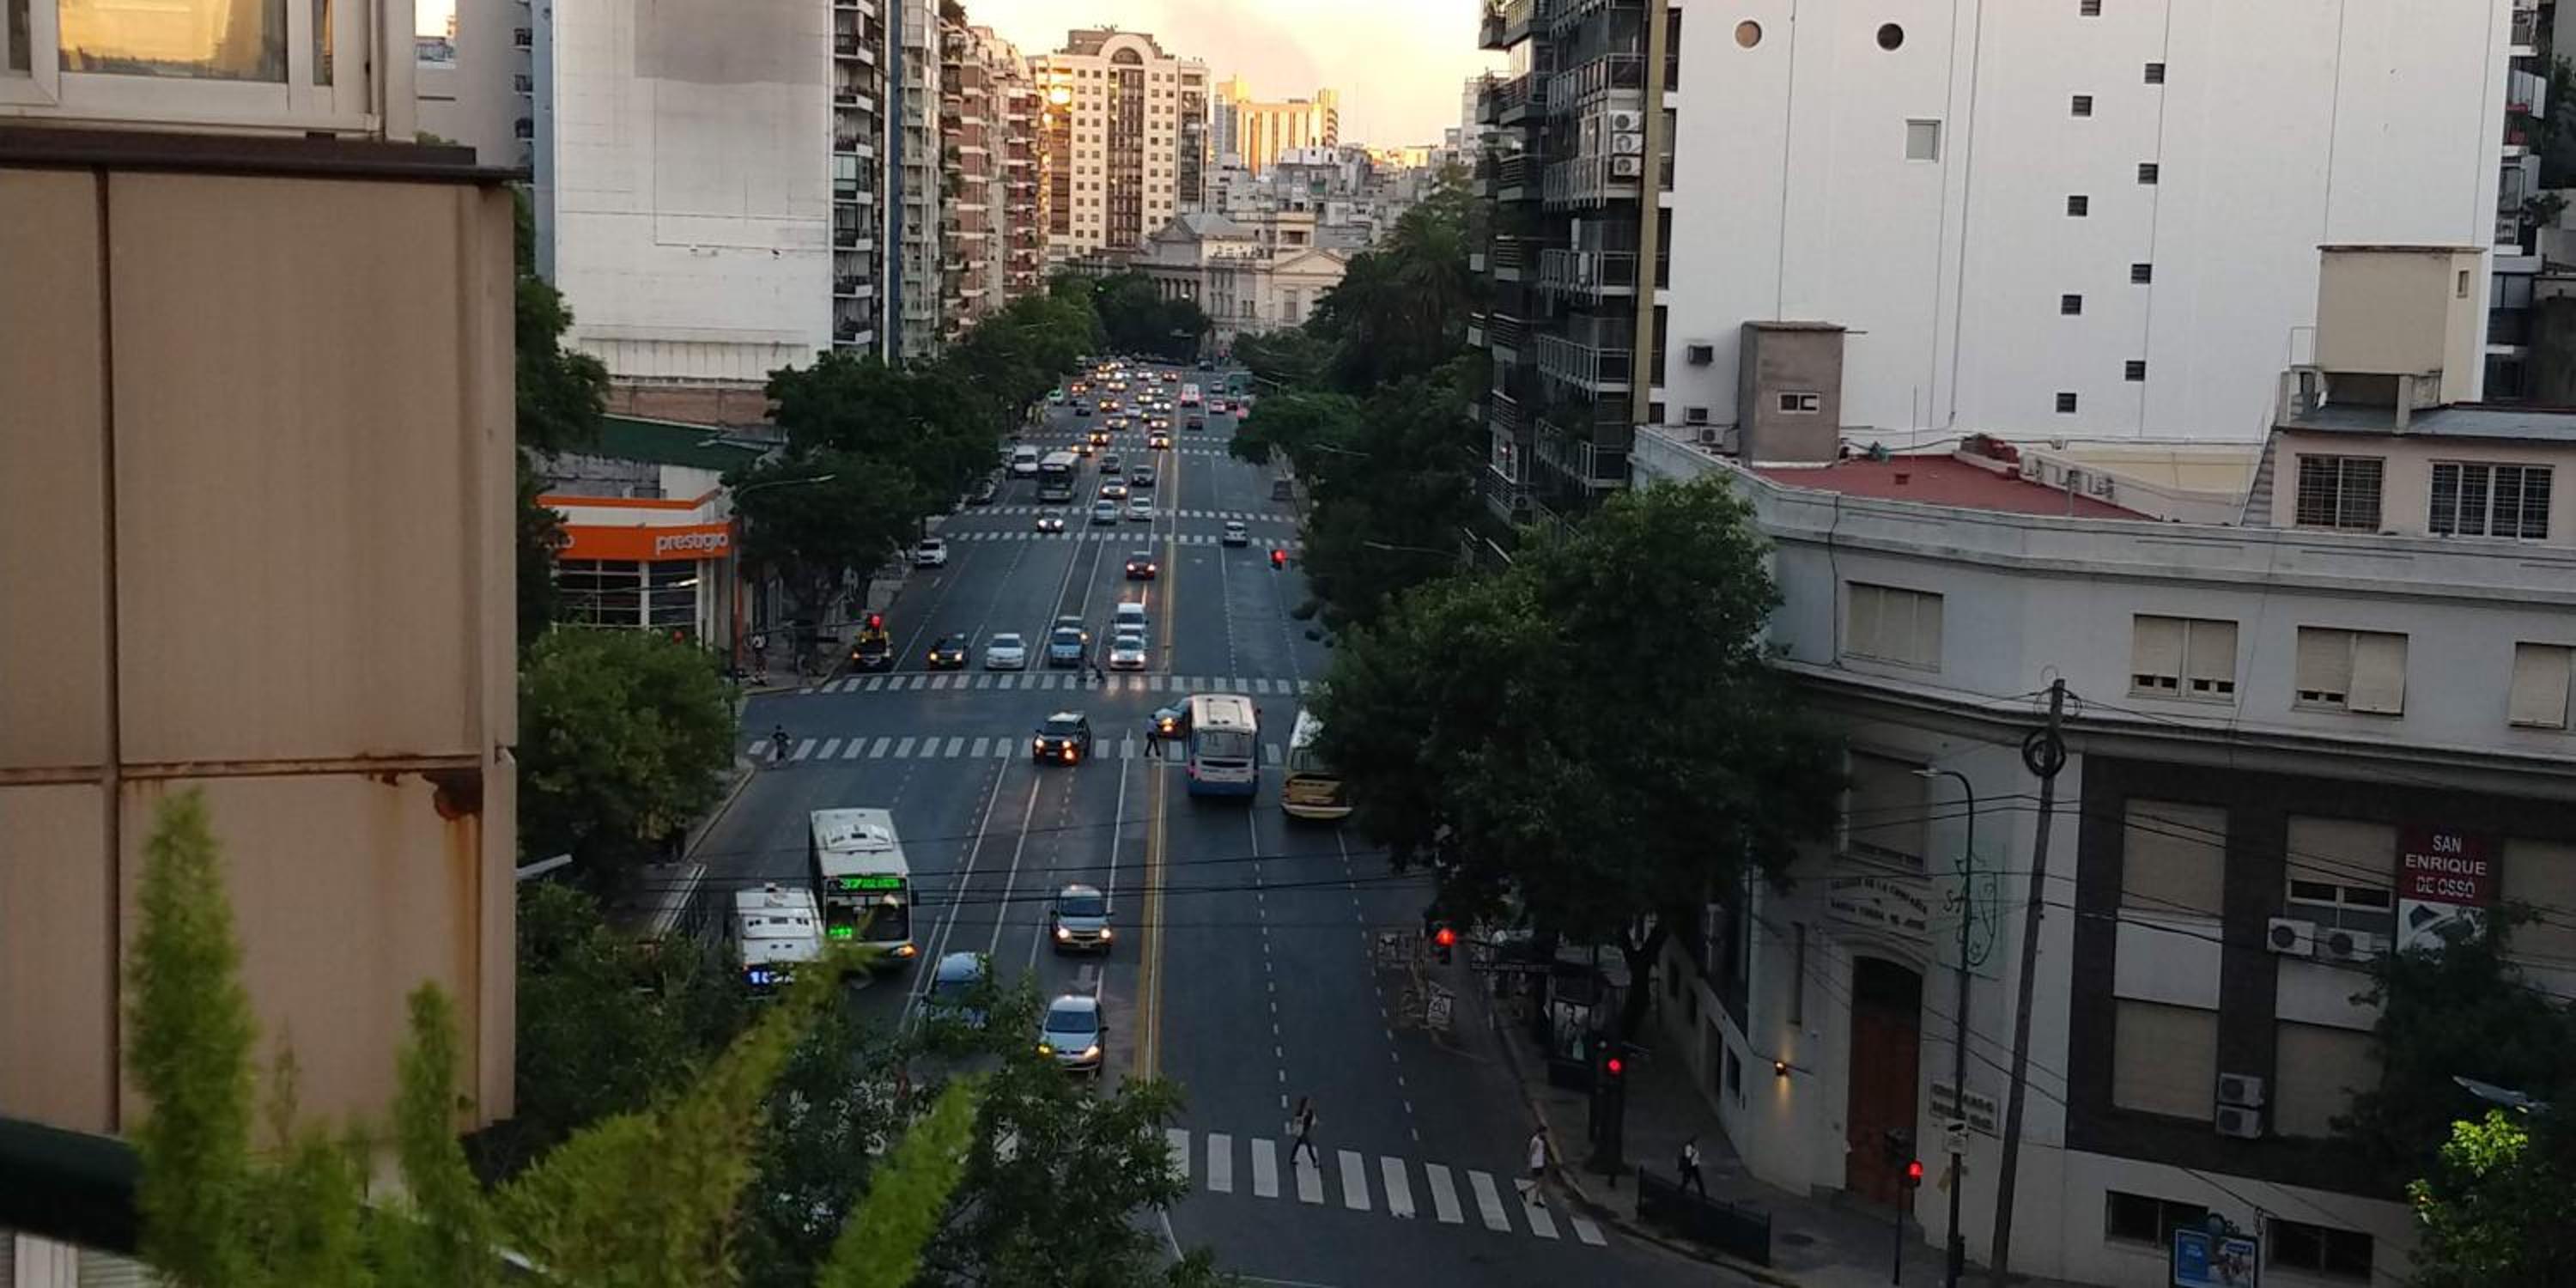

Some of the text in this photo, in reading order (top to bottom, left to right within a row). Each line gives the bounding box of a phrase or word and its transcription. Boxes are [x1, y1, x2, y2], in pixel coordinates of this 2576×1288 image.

[656, 533, 728, 555] prestigio
[2433, 835, 2462, 853] SAN
[2405, 853, 2488, 876] ENRIQUE
[2416, 875, 2436, 894] DE
